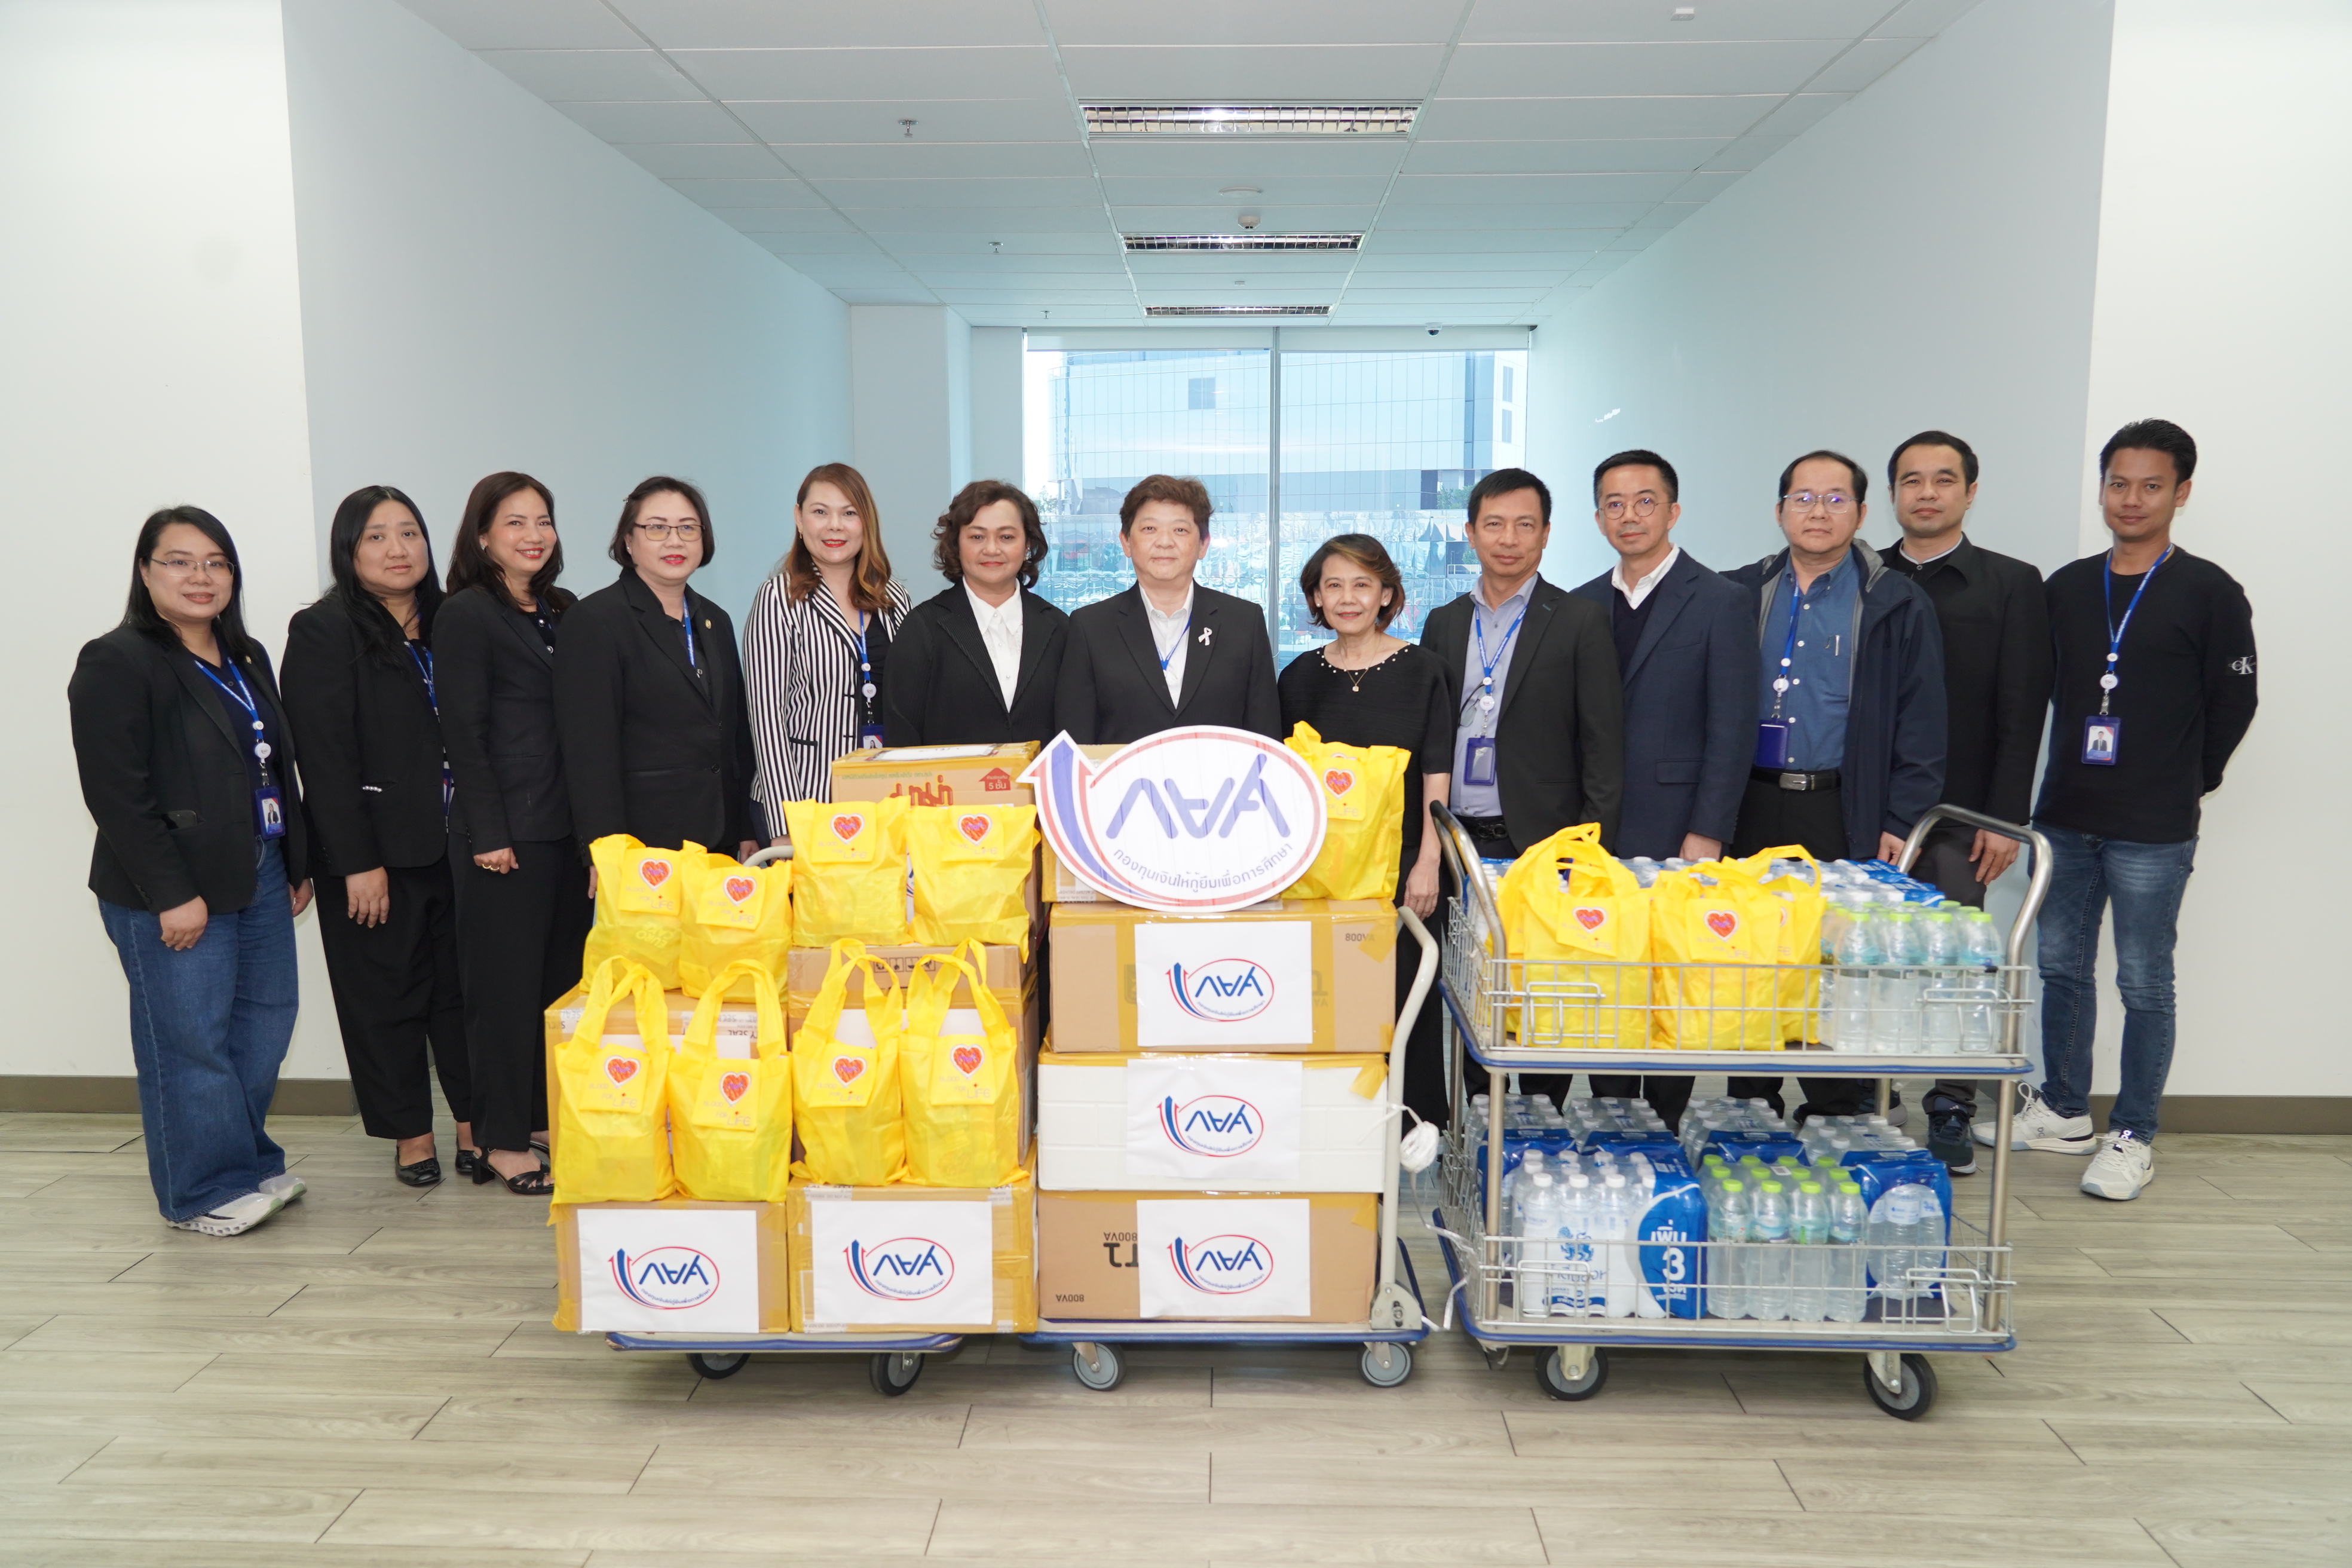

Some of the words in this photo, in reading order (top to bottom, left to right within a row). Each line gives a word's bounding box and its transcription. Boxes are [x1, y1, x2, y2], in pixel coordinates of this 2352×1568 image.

[1103, 1232, 1138, 1241] 800VA
[1662, 1247, 1686, 1281] 3
[1055, 1293, 1085, 1303] 800VA
